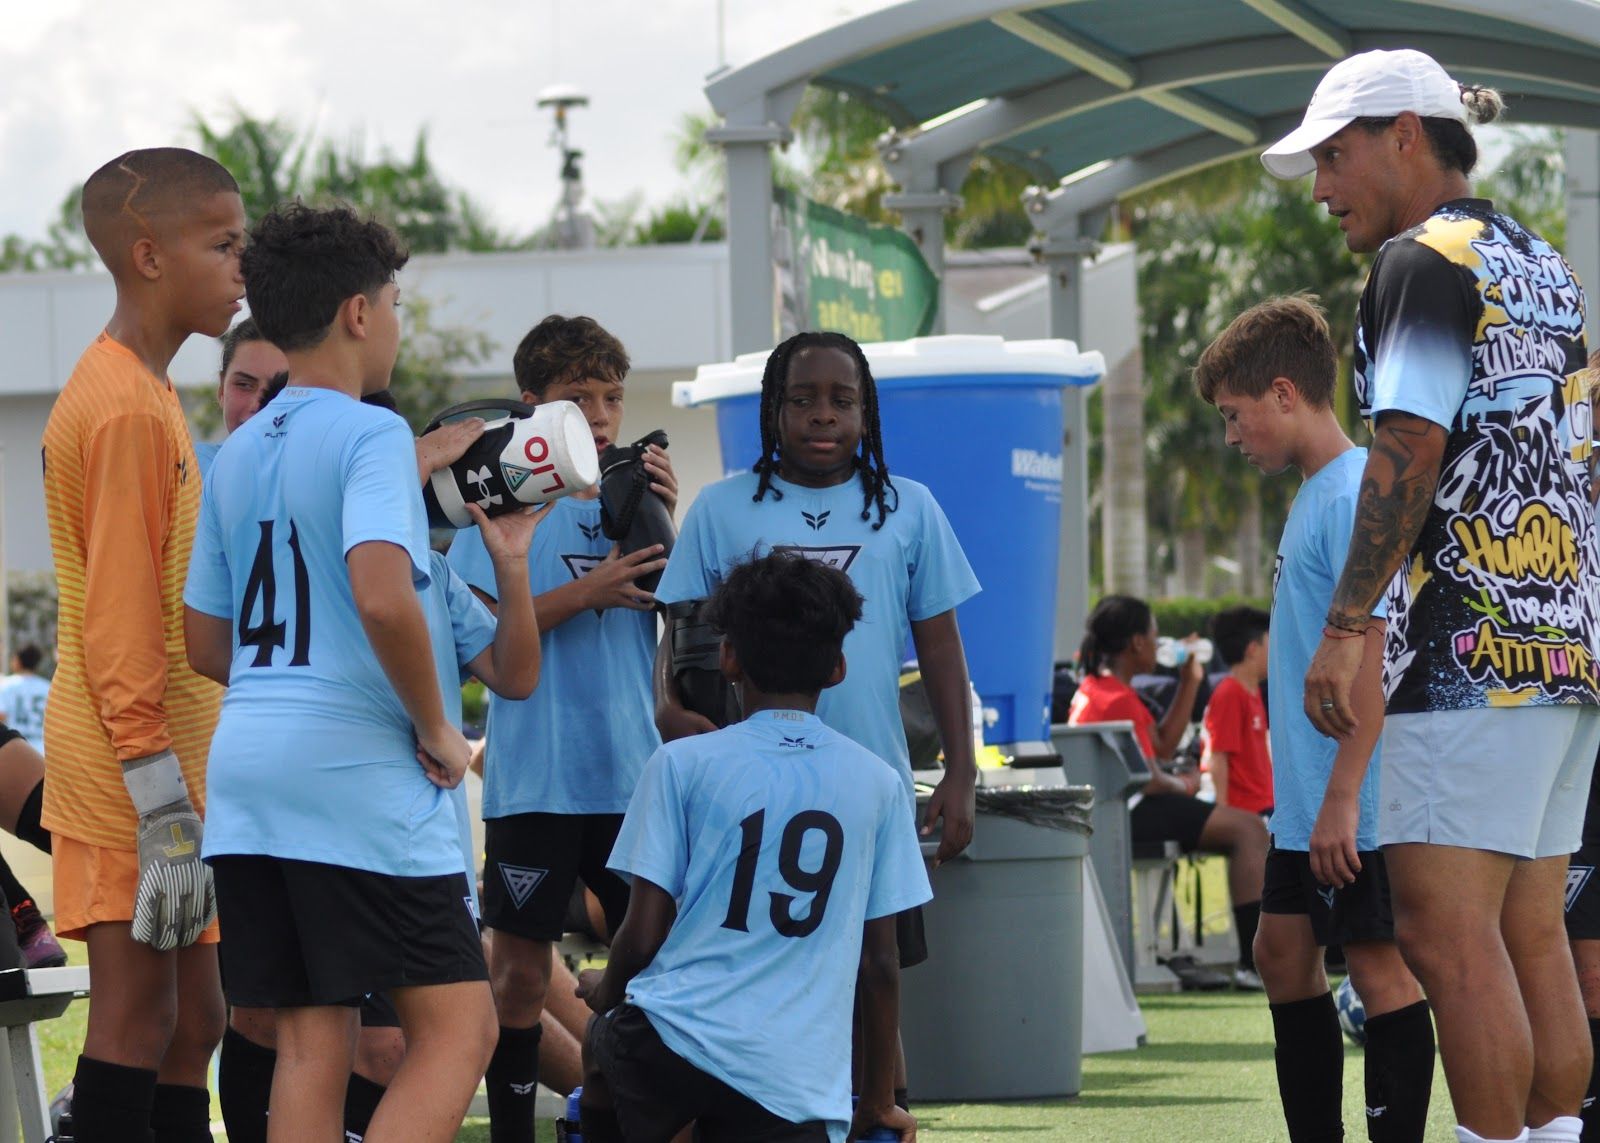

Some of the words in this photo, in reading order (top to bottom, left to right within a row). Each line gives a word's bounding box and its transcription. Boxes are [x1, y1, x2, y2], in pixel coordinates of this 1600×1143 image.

[239, 517, 311, 668] 41
[1454, 503, 1580, 583] HUMBLE
[720, 808, 845, 938] 19
